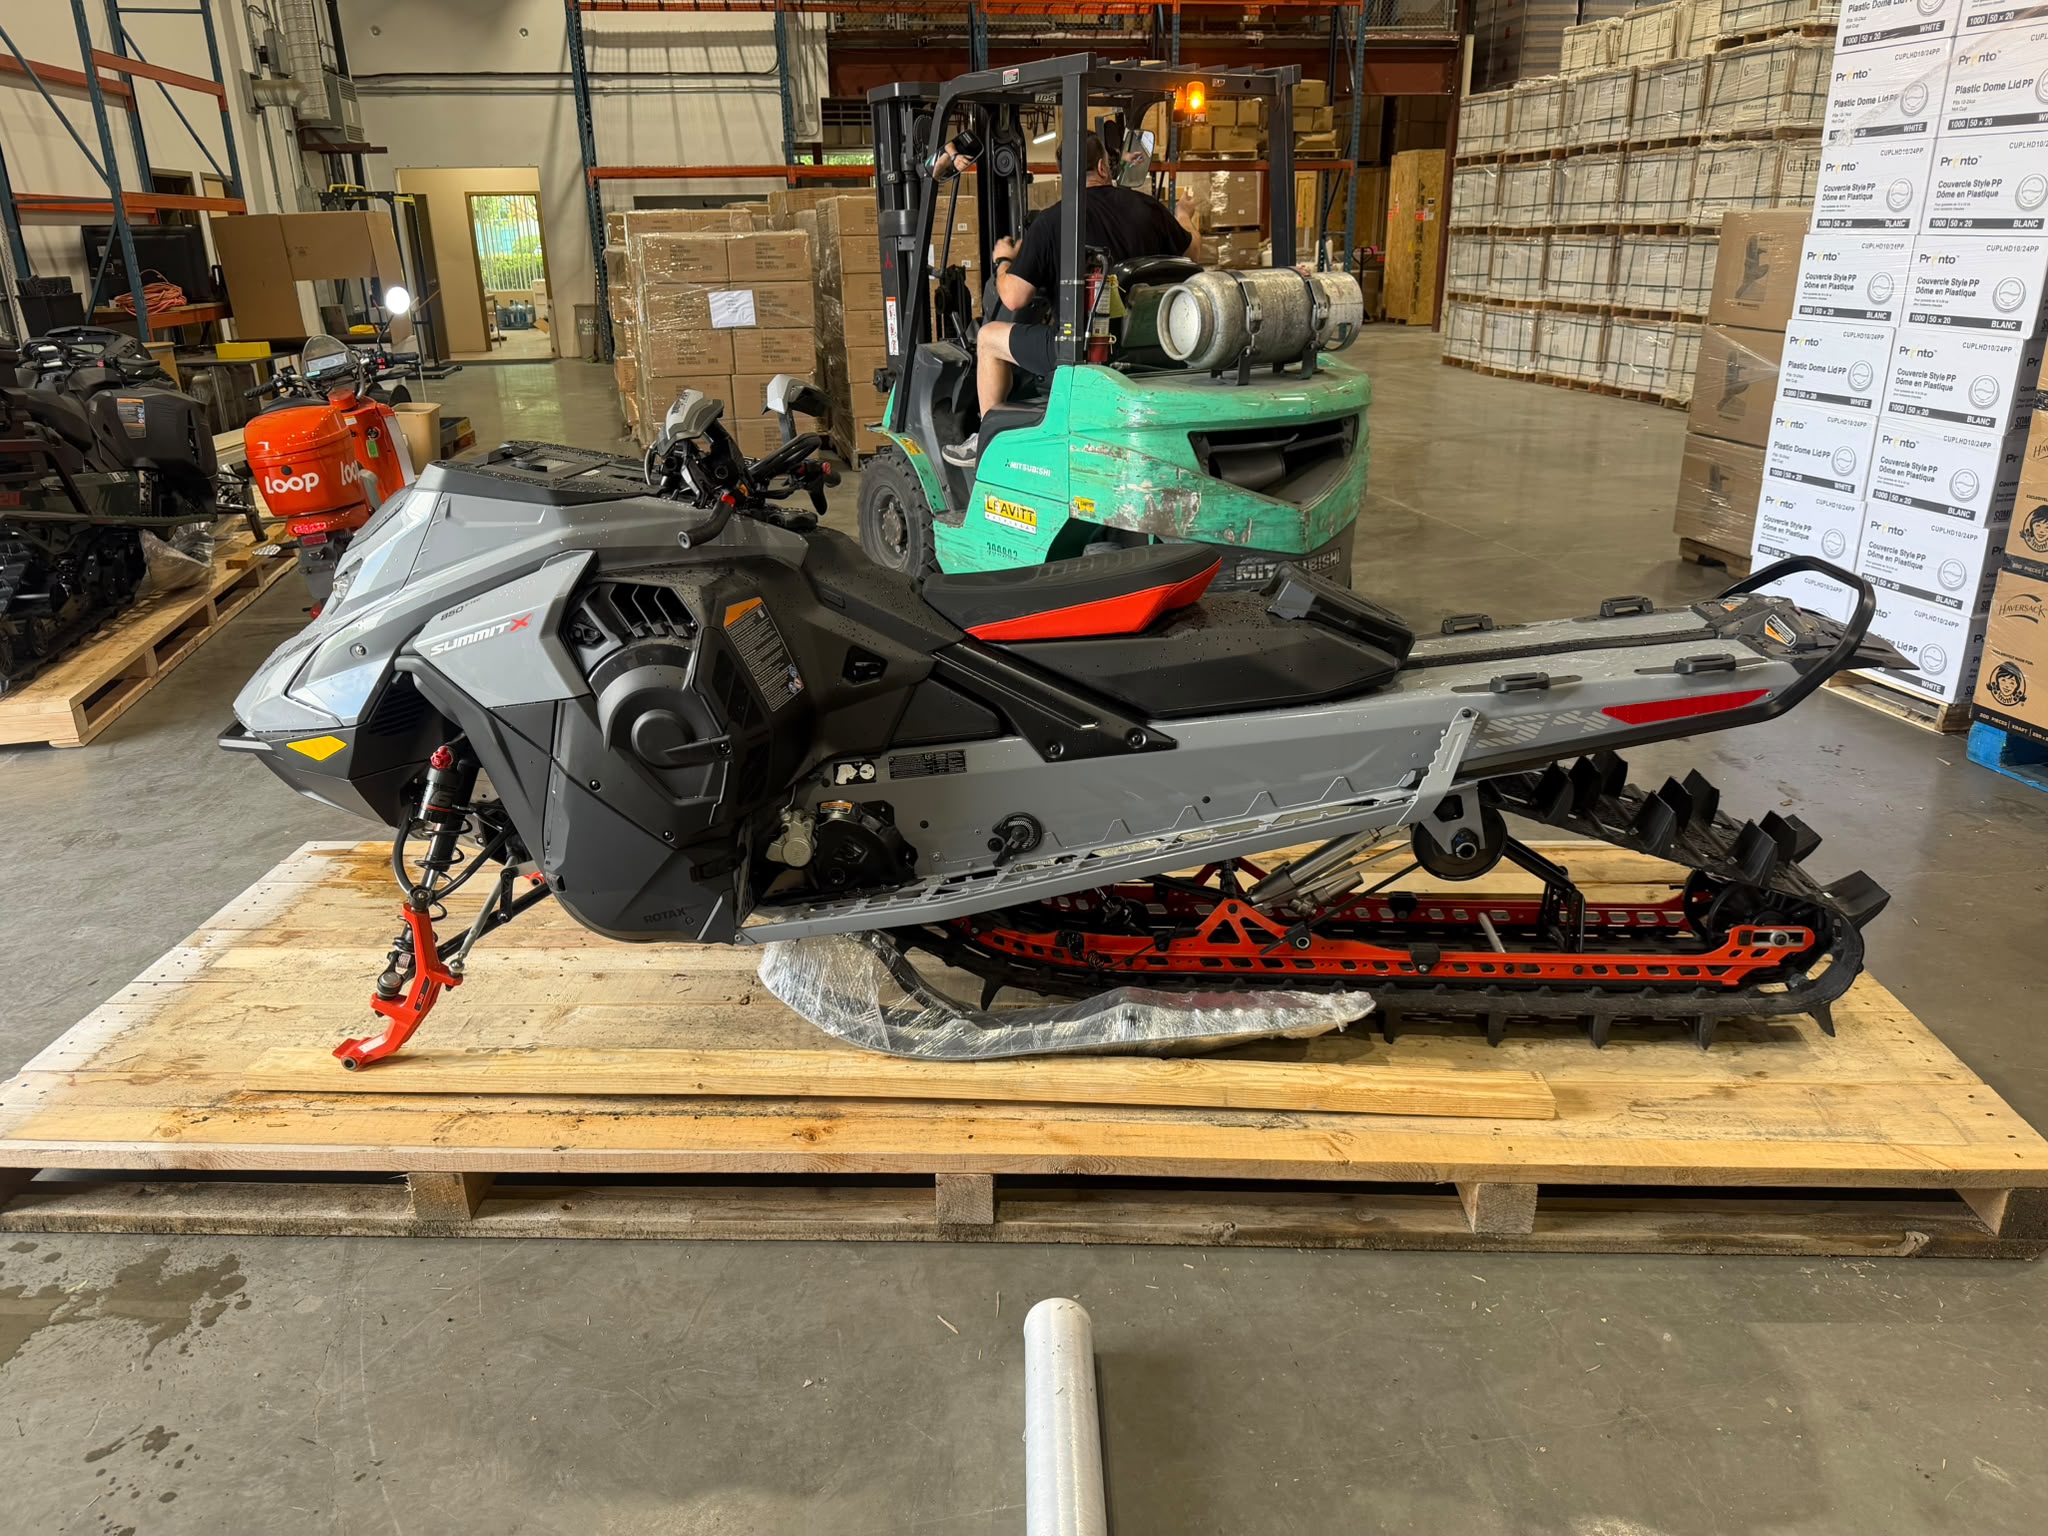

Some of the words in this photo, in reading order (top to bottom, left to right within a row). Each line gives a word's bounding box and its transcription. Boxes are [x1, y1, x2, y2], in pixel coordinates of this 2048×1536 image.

[1970, 16, 1985, 25] 1000
[1990, 14, 1998, 22] 50
[2006, 12, 2015, 20] 20
[1920, 22, 1941, 32] WHITE
[1845, 36, 1858, 44] 1000
[1861, 34, 1869, 42] 50
[1955, 84, 1980, 95] Plastic
[1983, 82, 2006, 92] Dome
[2008, 80, 2020, 90] Lid
[2022, 78, 2034, 88] PP
[1834, 98, 1856, 108] Plastic
[1857, 96, 1876, 106] Dome
[1904, 123, 1924, 133] WHITE
[1951, 120, 1965, 128] 1000
[1970, 118, 1978, 127] 50
[1984, 118, 1993, 126] 20
[1824, 184, 1851, 192] Couvercle
[1852, 183, 1866, 192] Style
[1938, 180, 1972, 189] Couvercle
[1973, 179, 1990, 189] Style
[1991, 179, 2003, 187] PP
[1847, 193, 1873, 201] Plastique
[1936, 190, 1955, 198] Dôme
[1967, 190, 1999, 199] Plastique
[1885, 219, 1906, 227] BLANC
[1932, 219, 1946, 227] 1000
[1950, 219, 1958, 227] 50
[1965, 219, 1973, 227] 20
[2013, 220, 2039, 228] BLANC
[1987, 244, 2039, 252] CUPLHD10/24PP
[1806, 273, 1832, 281] Couvercle
[1833, 274, 1847, 283] Style
[1917, 277, 1949, 286] Couvercle
[1951, 278, 1968, 287] Style
[1969, 279, 1980, 287] PP
[1828, 283, 1854, 291] Plastique
[1916, 286, 1934, 295] Dôme
[1945, 287, 1976, 298] Plastique
[1866, 311, 1888, 319] BLANC
[1912, 314, 1926, 322] 1000
[1928, 315, 1936, 323] 50
[1943, 316, 1951, 324] 20
[1991, 320, 2016, 329] BLANC
[1962, 342, 2012, 353] CUPLHD10/24PP
[1788, 361, 1807, 370] Plastic
[1809, 363, 1826, 372] Dome
[1827, 366, 1838, 374] Lid
[1838, 367, 1847, 375] PP
[1897, 368, 1928, 379] Couvercle
[1929, 371, 1946, 381] Style
[1946, 373, 1957, 382] PP
[1895, 377, 1913, 386] Dôme
[1923, 379, 1954, 392] Plastique
[1850, 399, 1869, 407] WHITE
[1891, 403, 1905, 412] 1000
[1908, 405, 1916, 414] 50
[1921, 408, 1929, 416] 20
[1967, 415, 1991, 425] BLANC
[1943, 435, 1991, 449] CUPLHD10/24PP
[1774, 441, 1793, 452] Plastic
[1794, 445, 1811, 455] Dome
[1812, 449, 1822, 458] Lid
[1822, 450, 1831, 458] PP
[1011, 462, 1051, 477] MITSUBISHI
[1880, 456, 1910, 469] Couvercle
[1912, 460, 1928, 472] Style
[1928, 464, 1938, 474] PP
[1879, 466, 1896, 476] Dôme
[1906, 468, 1935, 483] Plastique
[264, 472, 319, 494] loop
[1835, 482, 1853, 492] WHITE
[1875, 490, 1888, 500] 1000
[1891, 493, 1898, 502] 50
[1904, 496, 1912, 505] 20
[986, 495, 1035, 522] LEAVITT
[1947, 507, 1971, 518] BLANC
[1763, 514, 1789, 527] Couvercle
[1790, 520, 1803, 530] Style
[1804, 524, 1812, 532] PP
[1785, 527, 1809, 540] Plastique
[1931, 525, 1978, 541] CUPLHD10/24PP
[1868, 541, 1899, 556] Couvercle
[1900, 546, 1916, 560] Style
[1916, 553, 1927, 562] PP
[1867, 550, 1884, 561] Dôme
[1885, 555, 1893, 563] en
[1894, 556, 1923, 571] Plastique
[1880, 578, 1887, 587] 50
[1892, 582, 1900, 590] 20
[1935, 595, 1959, 608] BLANC
[441, 605, 464, 621] 850
[1999, 603, 2045, 618] HAVERSACK
[1914, 609, 1959, 628] CUPLHD10/24PP
[430, 622, 511, 657] SUMMIT
[509, 613, 533, 632] X
[1897, 642, 1908, 651] Lid
[1908, 645, 1918, 654] PP
[1921, 680, 1942, 693] WHITE
[643, 907, 686, 923] ROTAX
